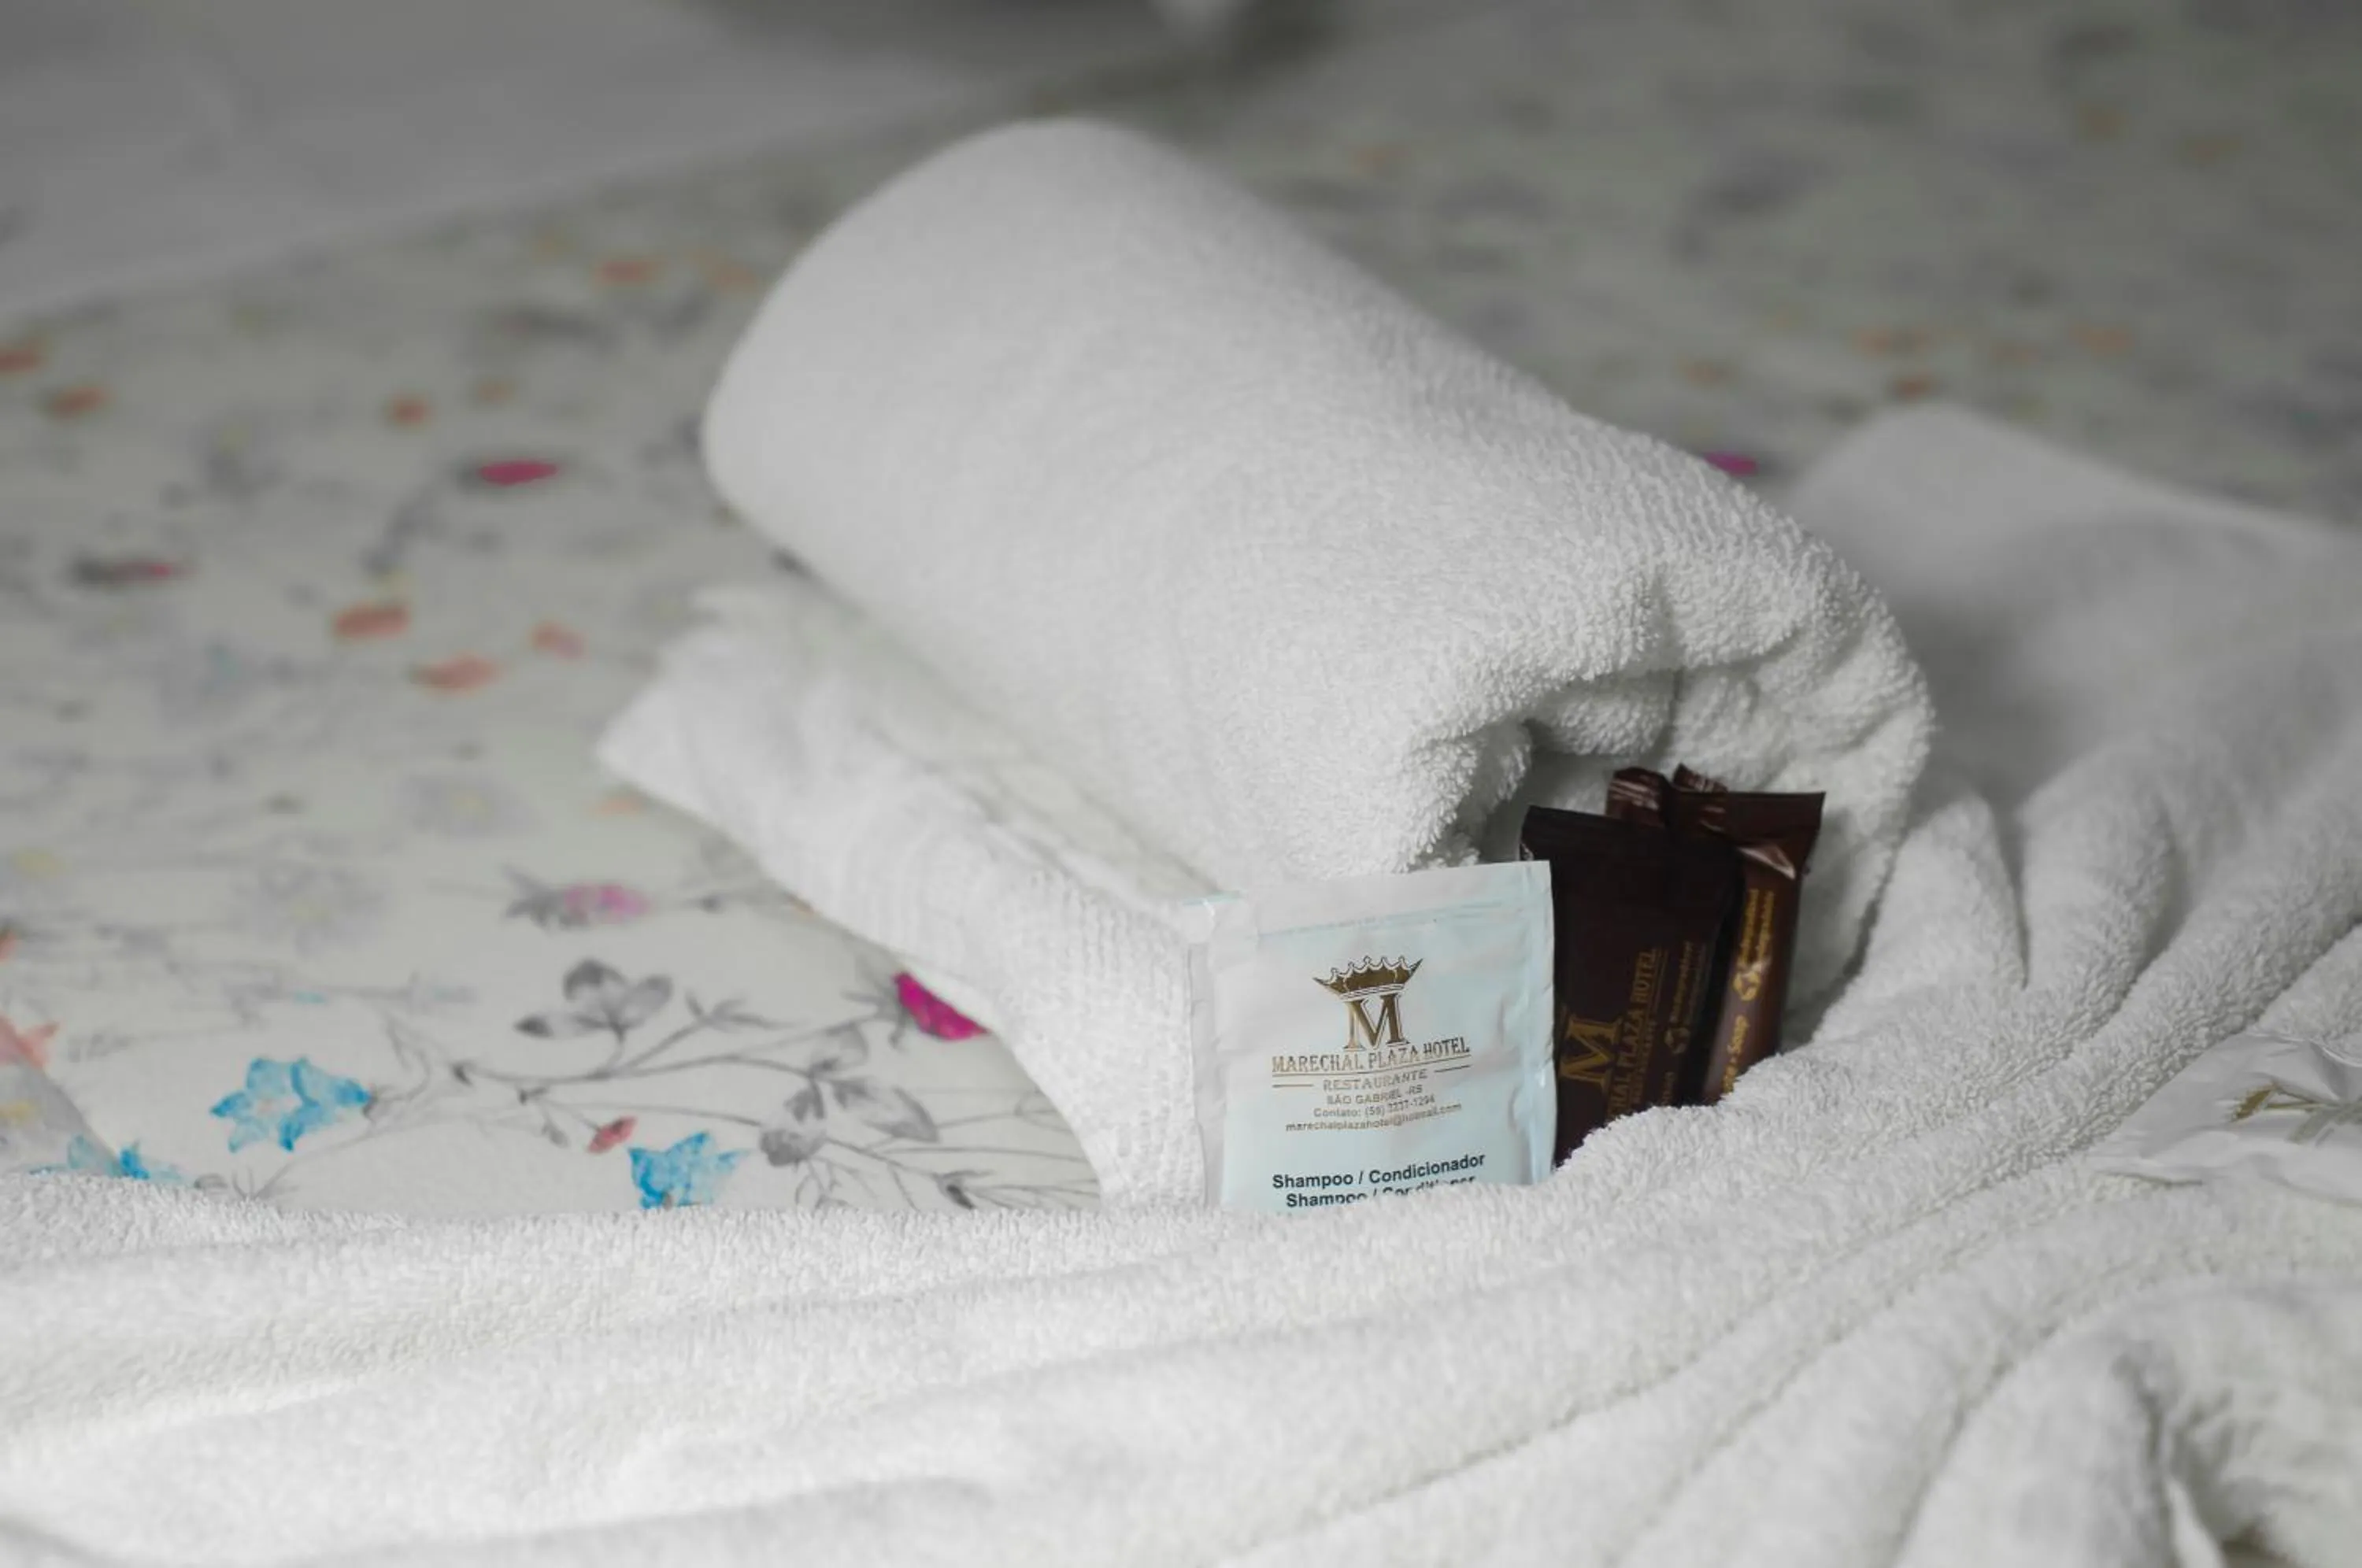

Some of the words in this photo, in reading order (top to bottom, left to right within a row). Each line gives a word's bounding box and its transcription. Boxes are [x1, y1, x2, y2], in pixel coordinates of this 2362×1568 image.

[1630, 949, 1657, 1004] HOTEL
[1343, 993, 1410, 1051] M
[1616, 1009, 1645, 1069] PLAZA
[1272, 1052, 1364, 1074] MARECHAL
[1368, 1045, 1419, 1069] PLAZA
[1422, 1036, 1470, 1062] HOTEL
[1323, 1069, 1428, 1091] RESTAURANTE
[1327, 1092, 1352, 1105] SÃO
[1355, 1089, 1401, 1105] GABRIEL
[1313, 1107, 1361, 1118] Contato:
[1272, 1172, 1353, 1189] Shampoo
[1368, 1153, 1486, 1184] Condicionador
